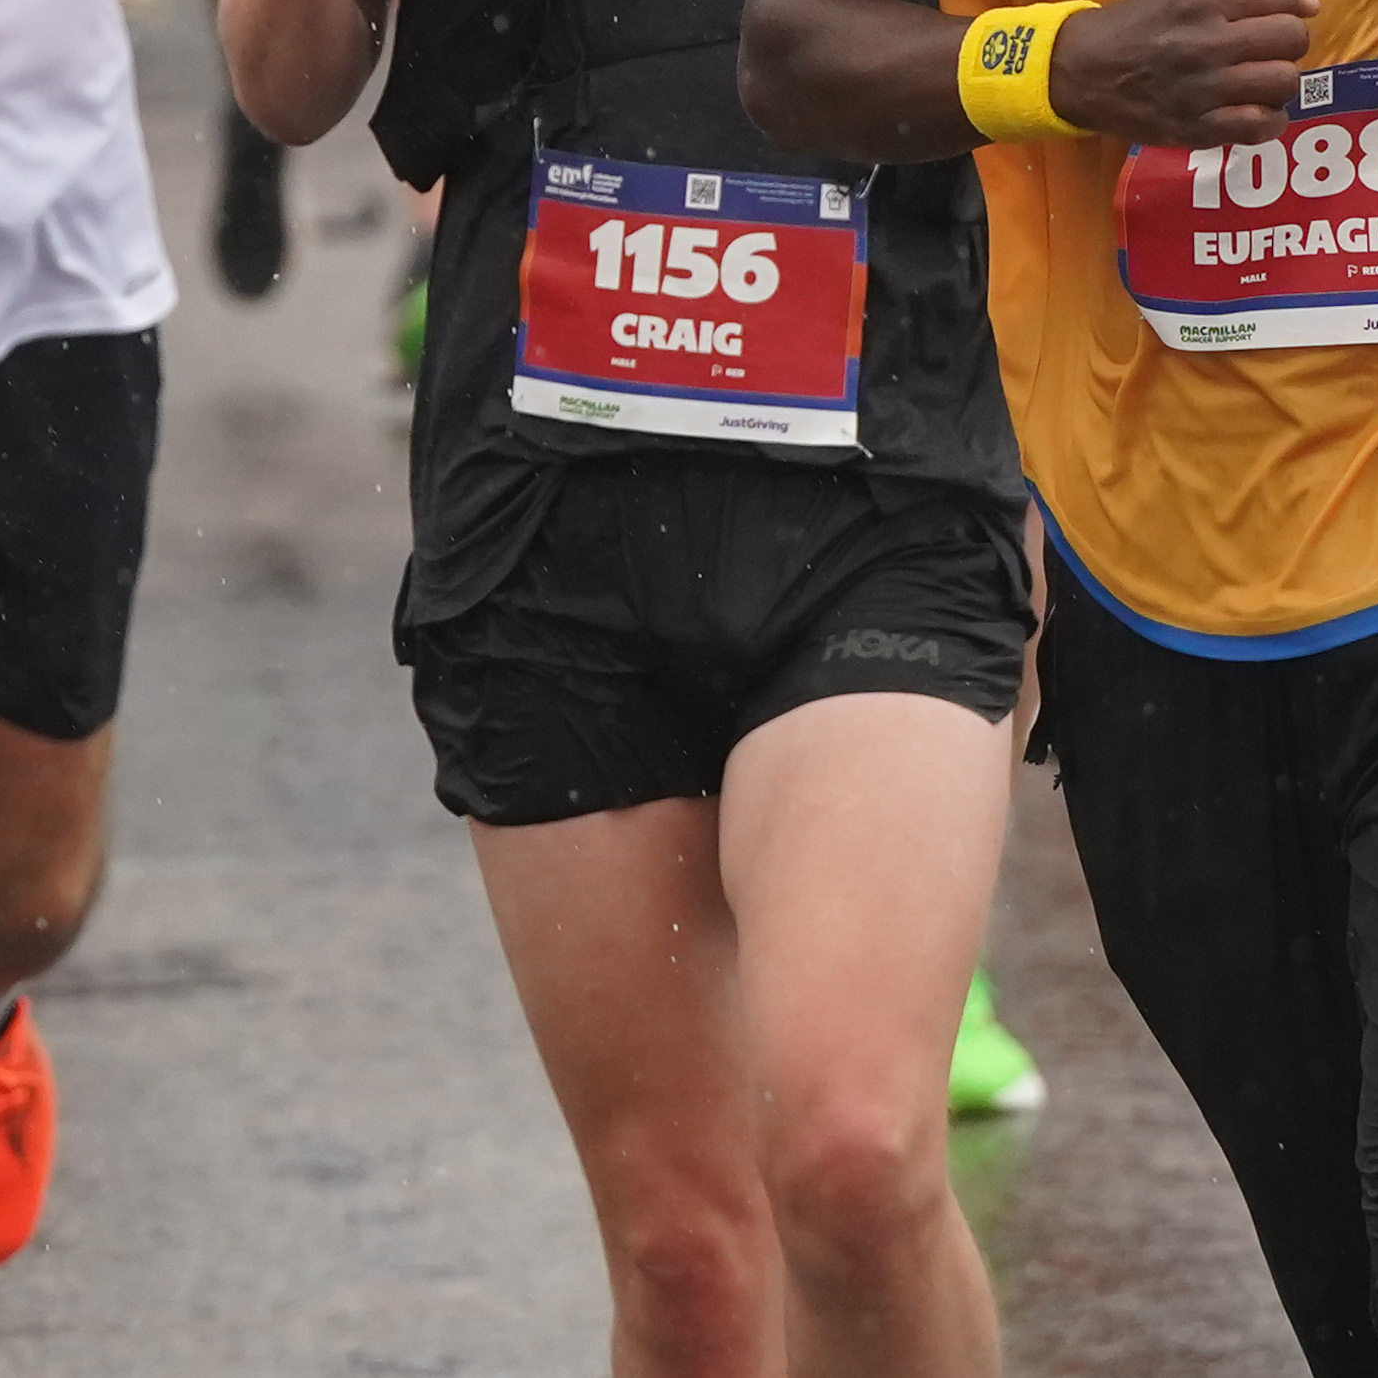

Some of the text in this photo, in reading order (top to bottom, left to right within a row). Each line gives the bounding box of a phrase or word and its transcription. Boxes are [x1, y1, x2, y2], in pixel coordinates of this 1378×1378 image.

[589, 219, 780, 304] 1156
[1240, 272, 1267, 285] MALE
[610, 313, 743, 357] CRAIG
[1180, 323, 1256, 336] MACMILLAN
[1215, 333, 1253, 343] SUPPORT
[719, 416, 790, 434] JustGiving
[824, 628, 940, 666] HOKA
